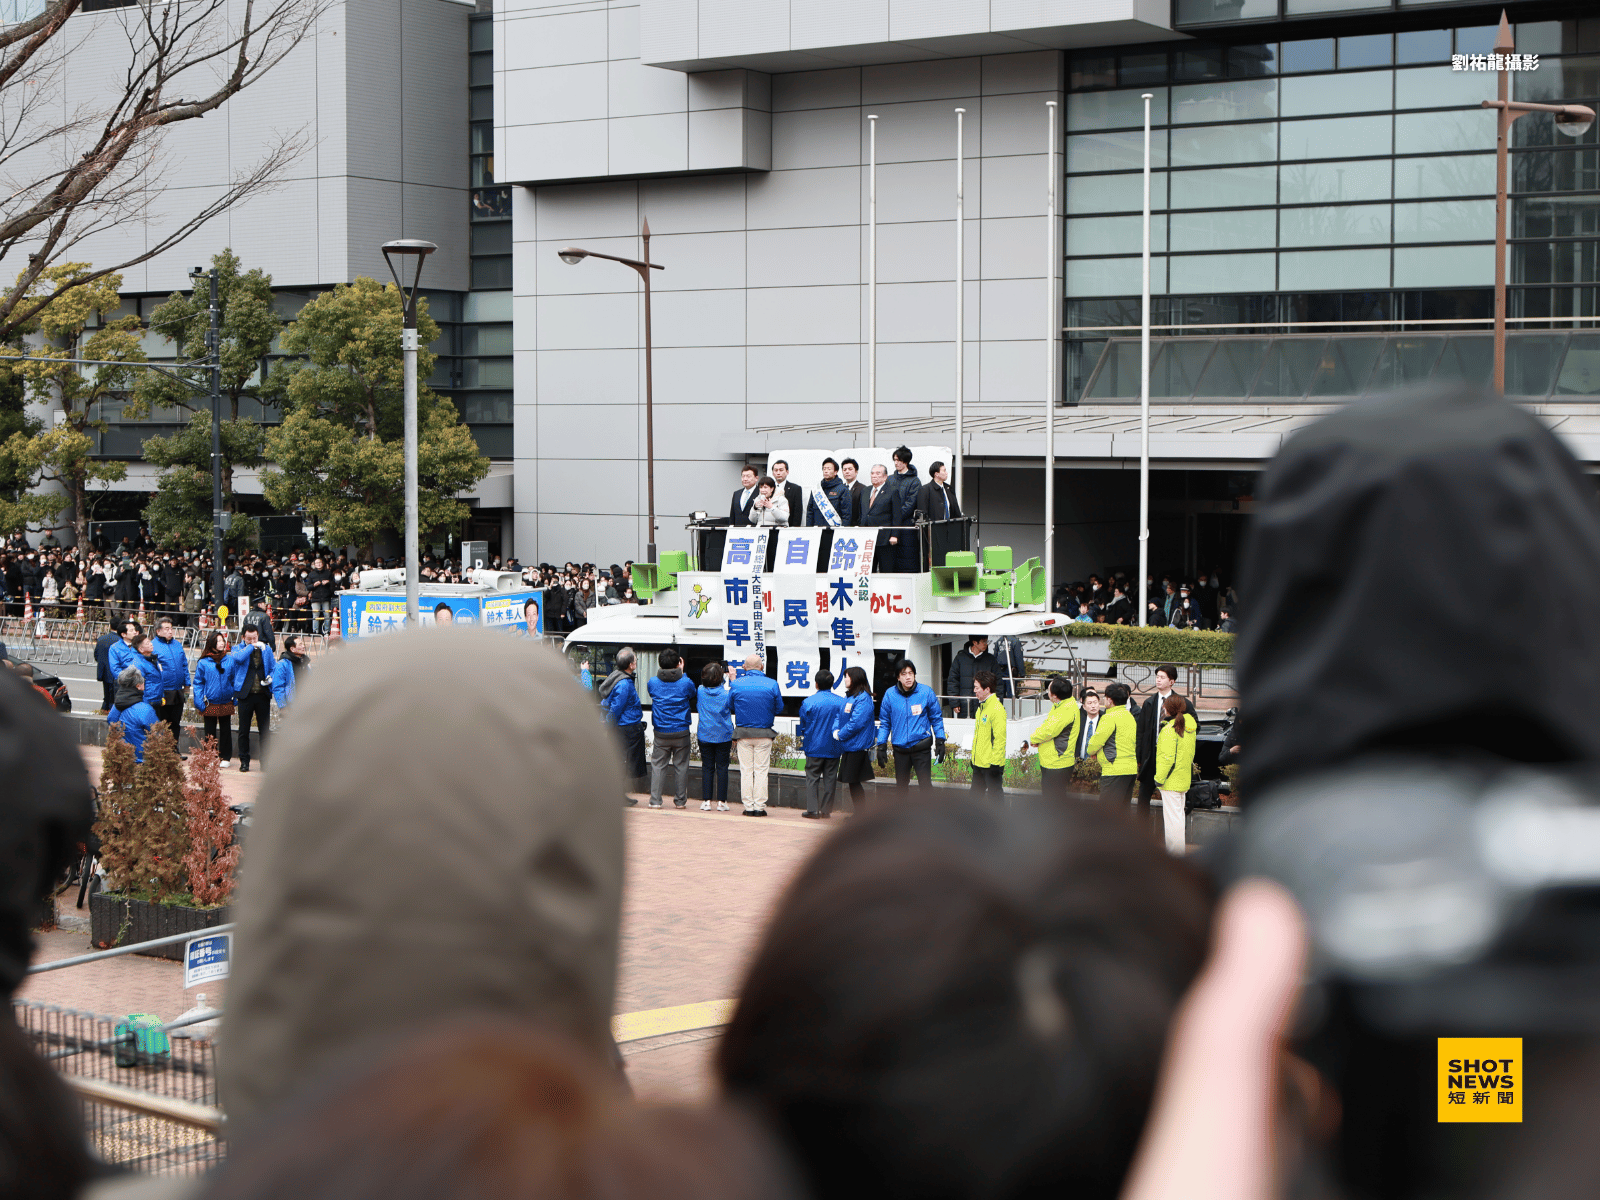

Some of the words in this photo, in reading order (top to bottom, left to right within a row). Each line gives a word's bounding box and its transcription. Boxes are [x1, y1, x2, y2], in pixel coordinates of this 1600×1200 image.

[783, 537, 810, 689] 自民党
[859, 539, 874, 601] 自民党公認
